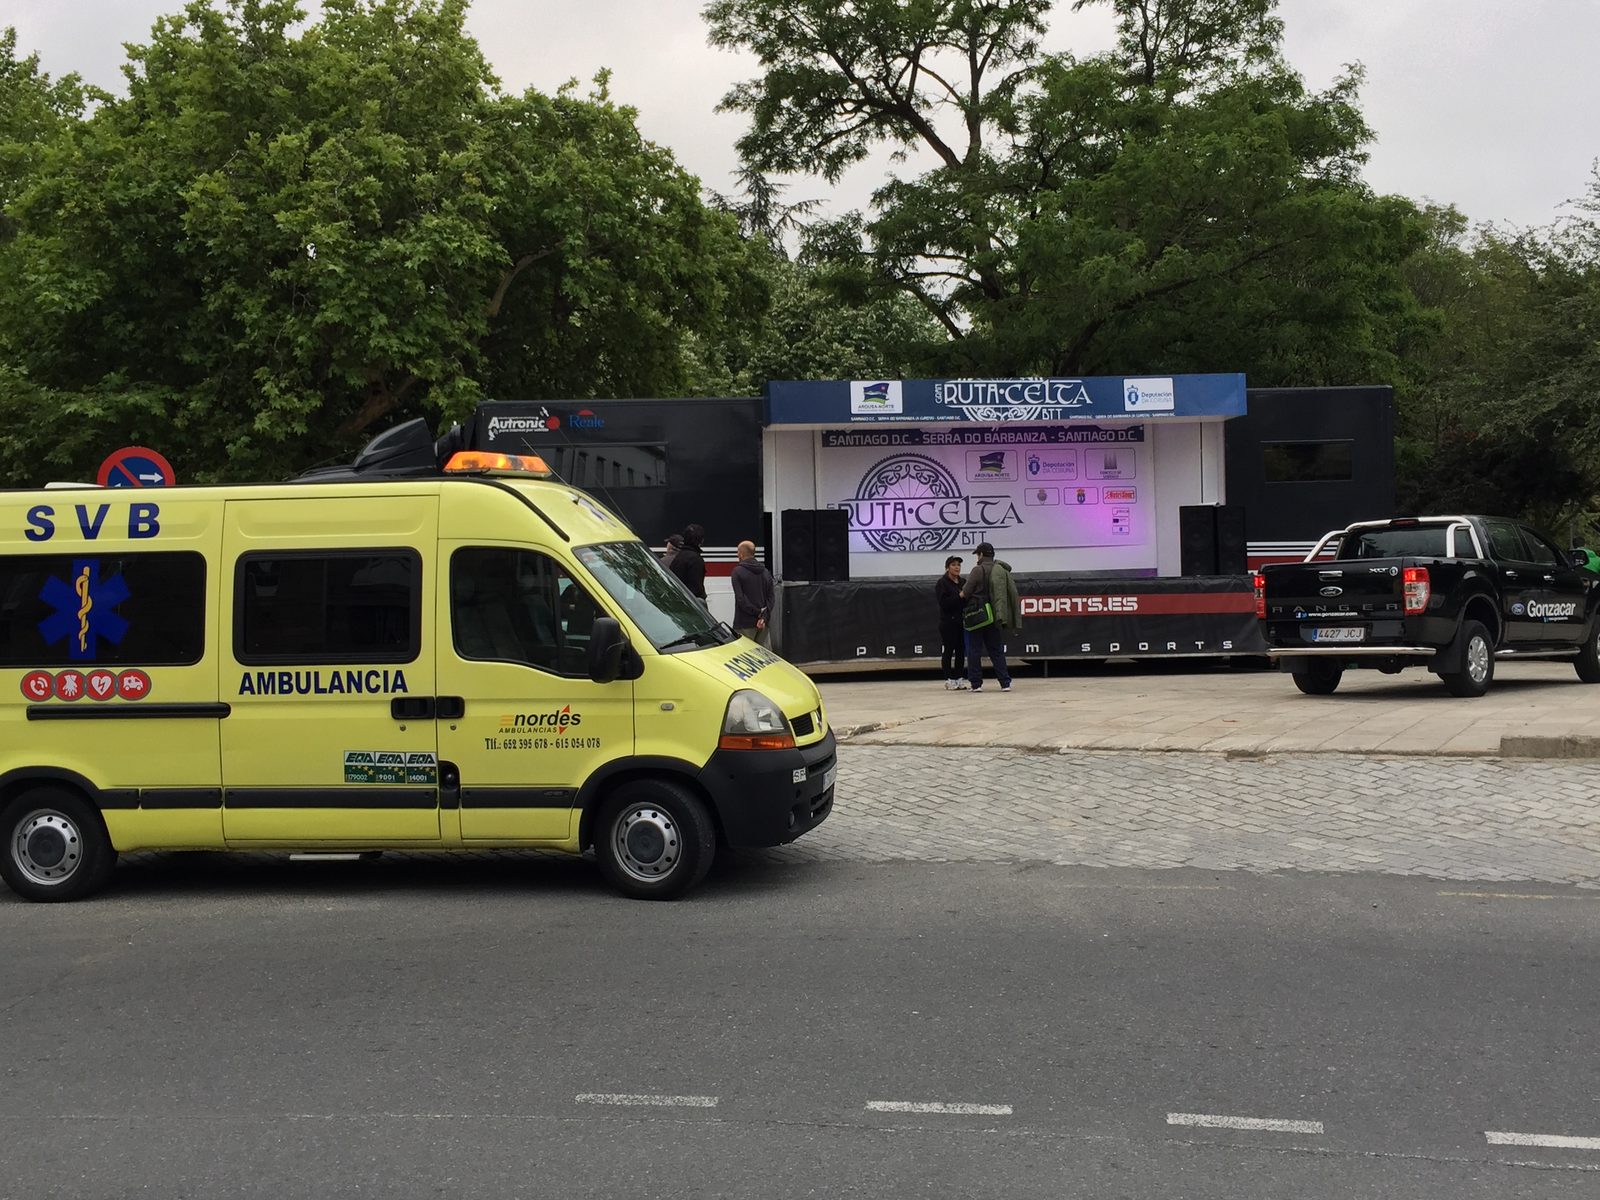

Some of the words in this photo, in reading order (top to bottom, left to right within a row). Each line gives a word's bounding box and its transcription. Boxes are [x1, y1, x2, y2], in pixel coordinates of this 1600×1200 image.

[569, 414, 605, 428] Reale
[1042, 408, 1063, 420] BTT
[488, 416, 546, 429] Autronic
[829, 434, 889, 446] SANTIAGO
[892, 434, 912, 445] D.C.
[923, 433, 961, 444] SERRA
[964, 433, 981, 444] DO
[984, 432, 1048, 443] BARBANZA
[1058, 431, 1116, 442] SANTIAGO
[1118, 430, 1138, 441] D.C.
[961, 531, 987, 545] BTT
[1020, 597, 1138, 615] PORTS.ES
[1272, 603, 1397, 613] RANGER
[1527, 600, 1576, 618] Gonzacar
[1318, 629, 1341, 638] 4427
[1344, 629, 1362, 638] JCJ
[238, 669, 409, 696] AMBULANCIA
[503, 738, 517, 749] 652
[519, 738, 532, 749] 395
[534, 738, 548, 749] 678
[555, 738, 569, 749] 615
[571, 738, 585, 748] 054
[587, 737, 601, 748] 078
